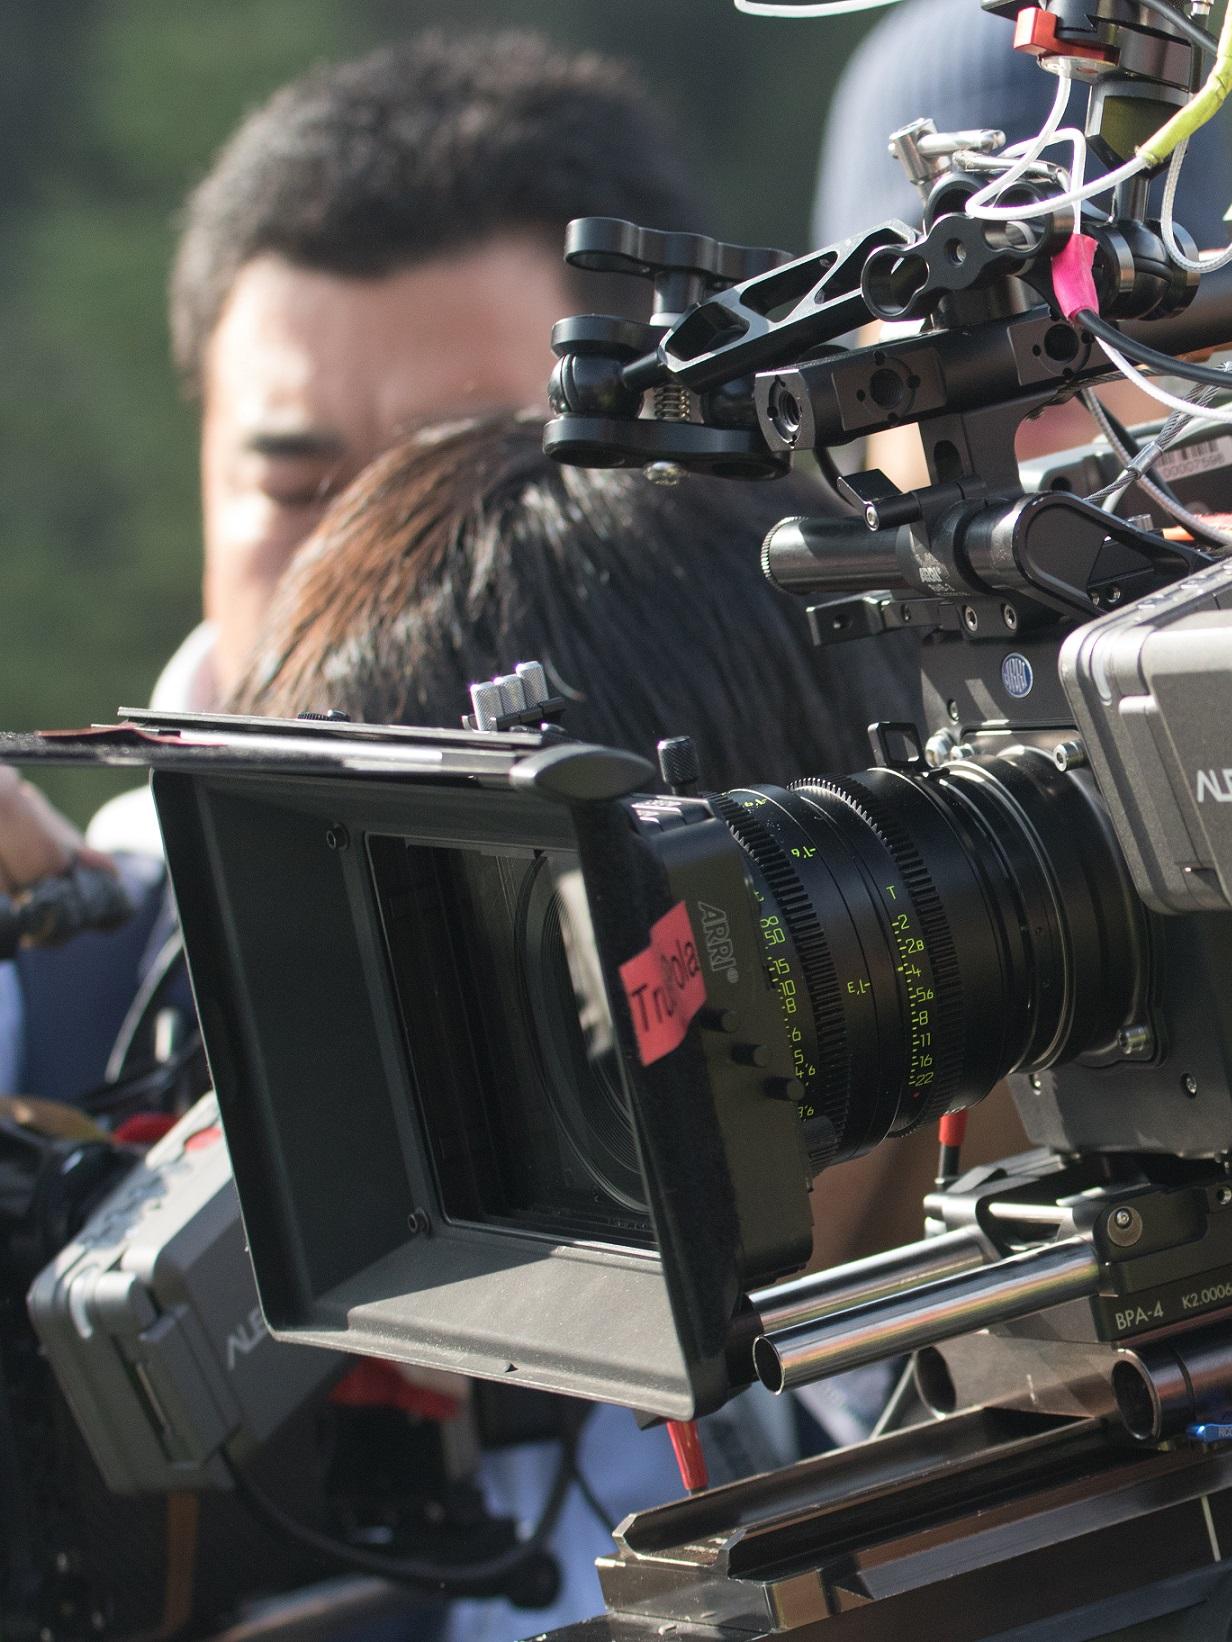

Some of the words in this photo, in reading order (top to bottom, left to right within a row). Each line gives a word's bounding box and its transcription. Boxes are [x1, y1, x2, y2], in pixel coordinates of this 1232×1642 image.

[886, 885, 897, 900] T
[898, 914, 910, 930] 2
[764, 928, 786, 945] 50
[773, 958, 790, 974] 15
[911, 964, 921, 977] 4
[780, 979, 796, 996] 10
[785, 998, 797, 1013] 8
[919, 1010, 929, 1026] 8
[792, 1027, 801, 1041] 6
[920, 1032, 931, 1047] 11
[794, 1049, 804, 1065] 5
[920, 1054, 933, 1068] 16
[915, 1072, 934, 1087] 22
[1115, 1301, 1164, 1331] BPA-4
